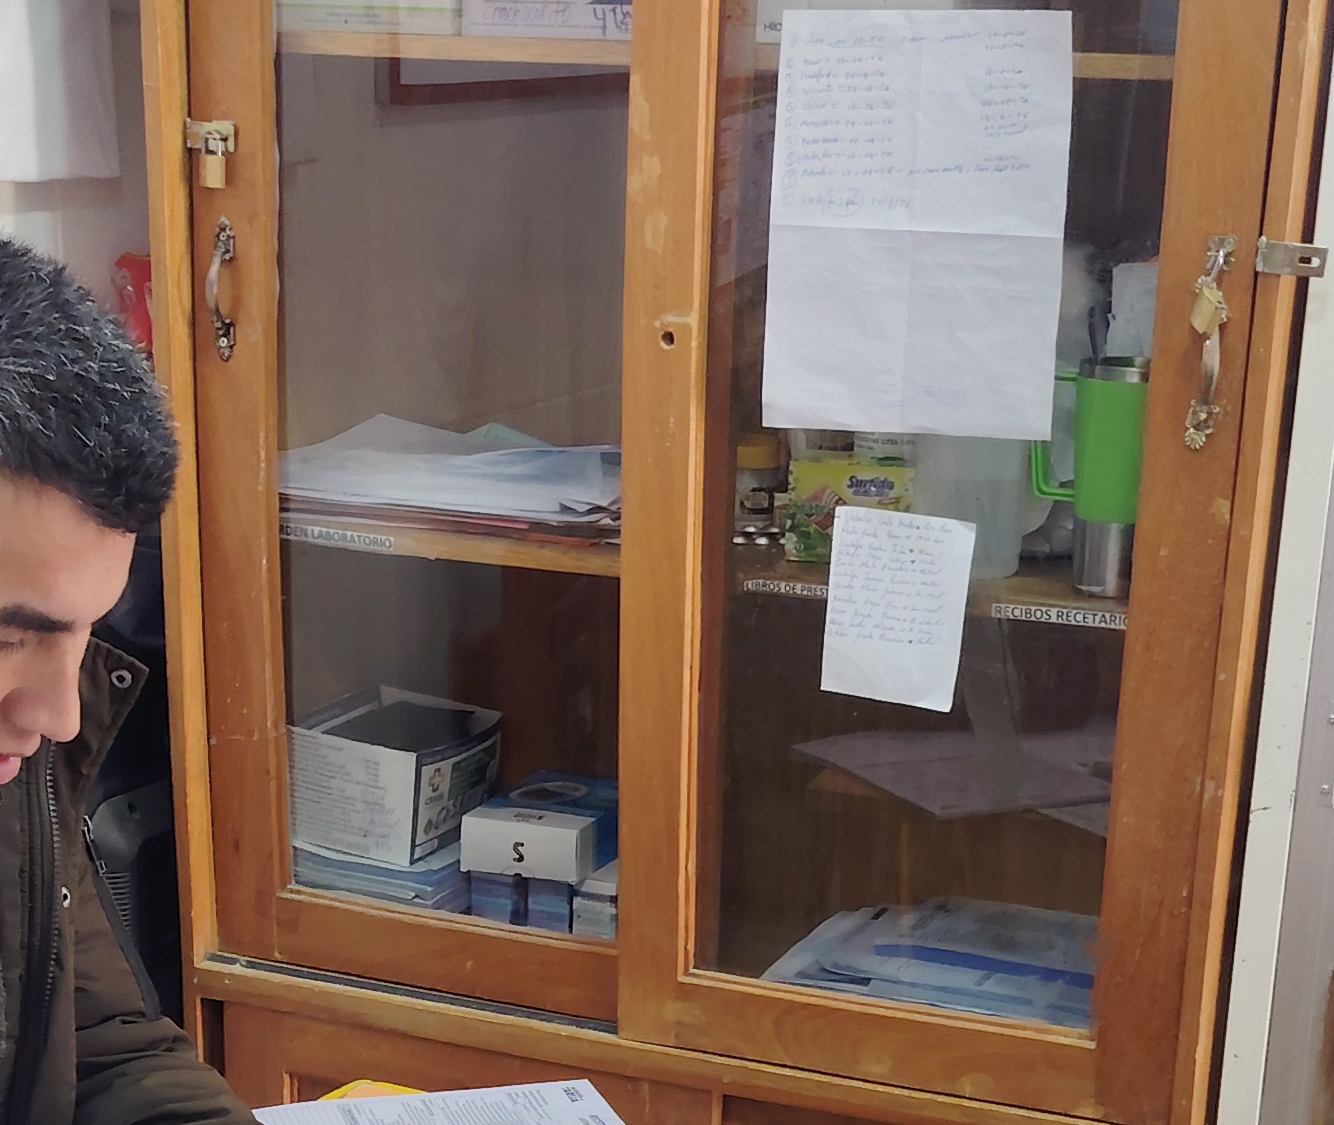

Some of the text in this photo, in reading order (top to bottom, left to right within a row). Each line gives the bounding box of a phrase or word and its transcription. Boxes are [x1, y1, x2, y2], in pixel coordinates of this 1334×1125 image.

[846, 475, 895, 491] Surtido
[311, 528, 393, 549] LABORATORIO
[746, 580, 782, 592] LIBROS
[784, 583, 800, 594] DE
[994, 605, 1052, 620] RECIBOS
